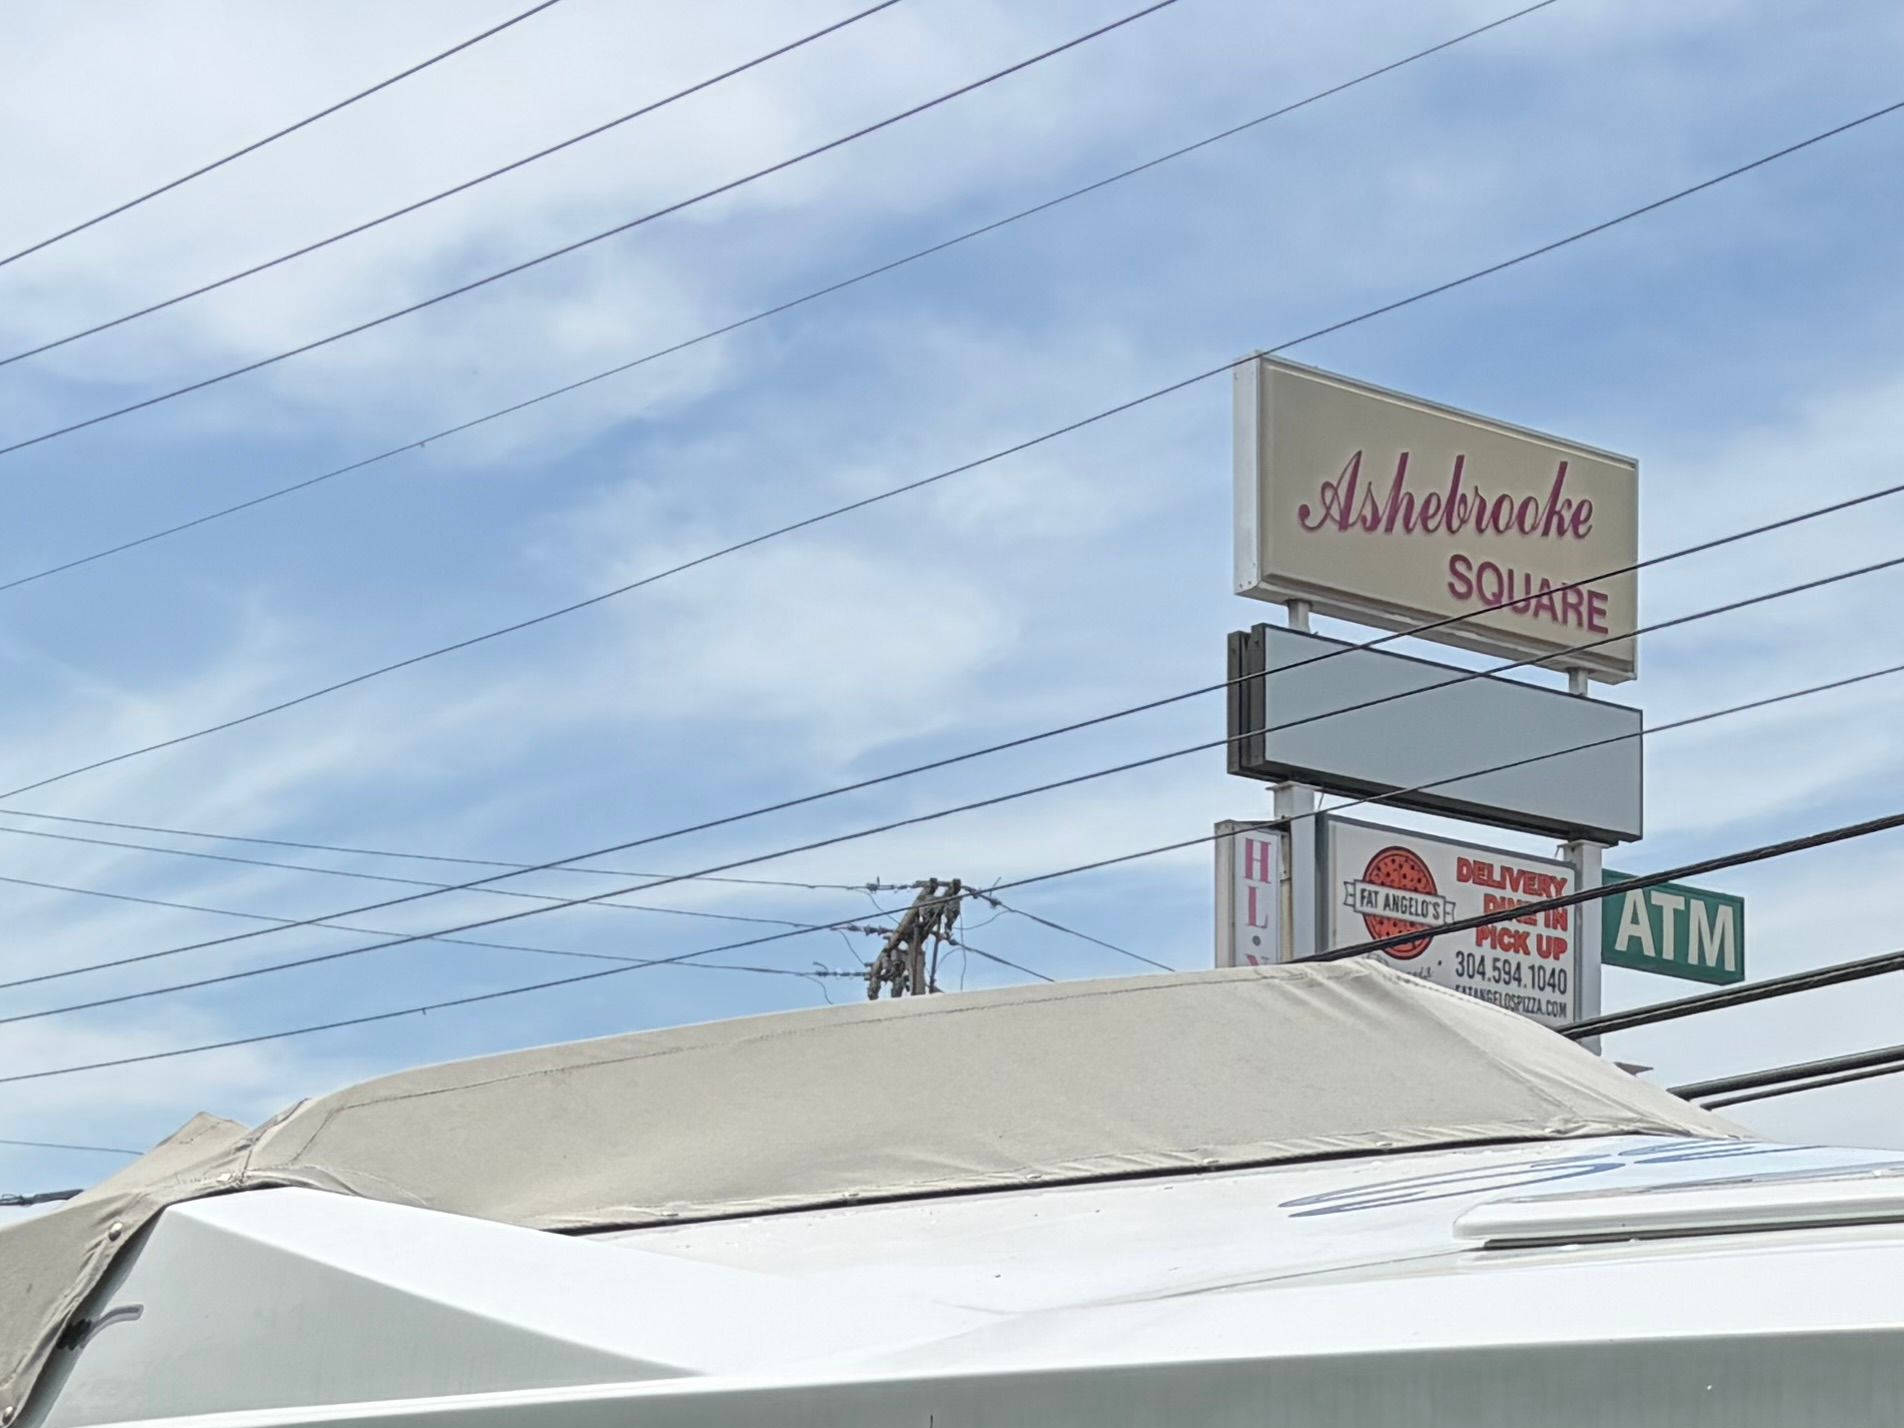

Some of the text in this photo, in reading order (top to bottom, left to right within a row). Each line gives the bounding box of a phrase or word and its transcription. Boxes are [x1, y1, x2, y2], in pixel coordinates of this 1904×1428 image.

[1298, 449, 1593, 539] Ashebrooke
[1447, 554, 1609, 635] SQUARE
[1456, 857, 1568, 898] DELIVERY
[1360, 888, 1441, 920] FAT ANGELO'S
[1544, 905, 1568, 932] IN
[1476, 925, 1568, 961] PICK UP
[1614, 888, 1736, 971] ATM
[1455, 951, 1567, 995] 304.594.1040
